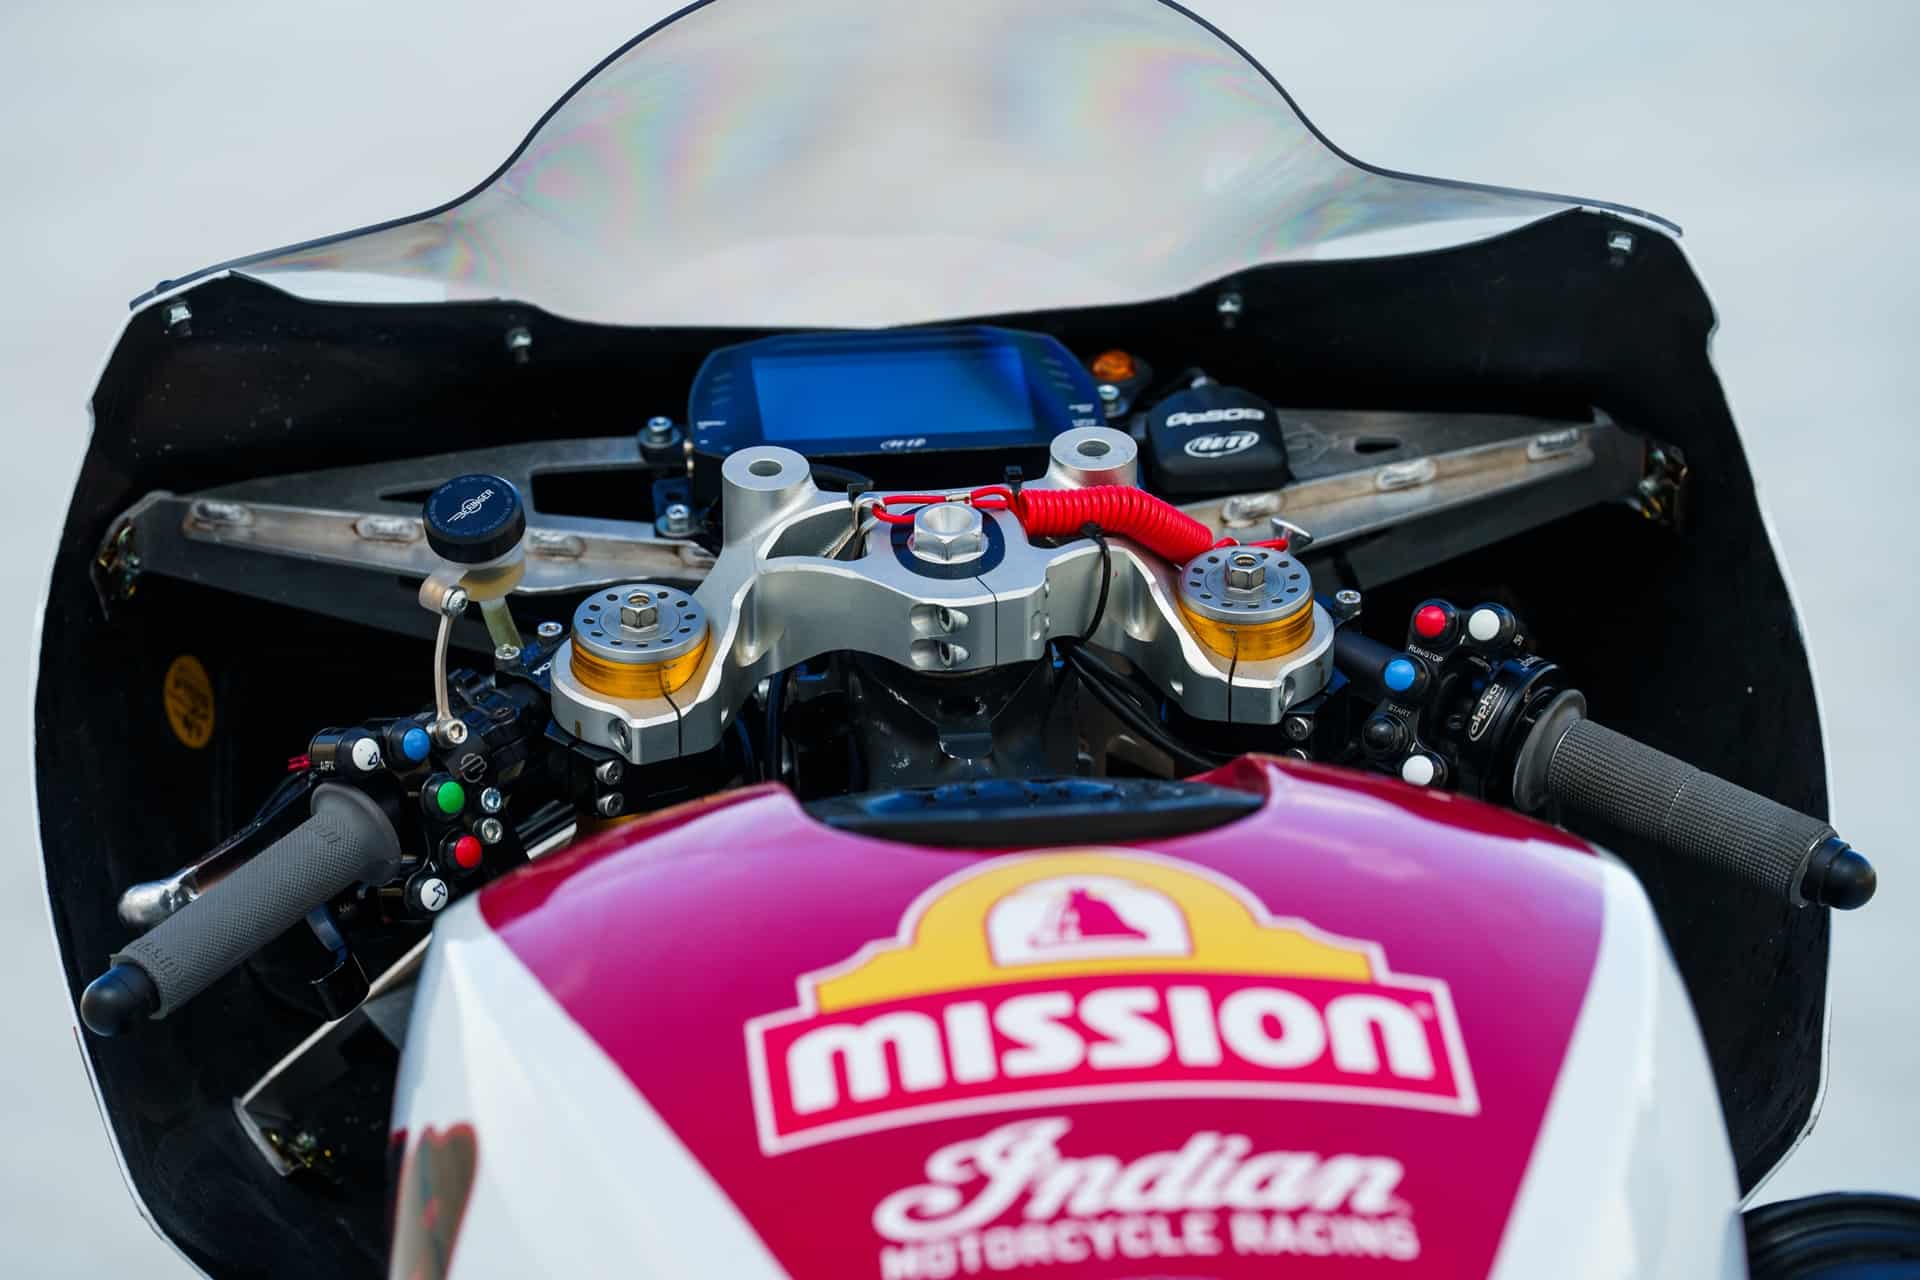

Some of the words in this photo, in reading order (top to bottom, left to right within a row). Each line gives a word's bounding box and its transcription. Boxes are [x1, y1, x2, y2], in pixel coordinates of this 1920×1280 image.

[872, 1116, 1405, 1243] Indian
[879, 1210, 1223, 1280] MOTORCYCLE
[1229, 1210, 1421, 1262] RACING
